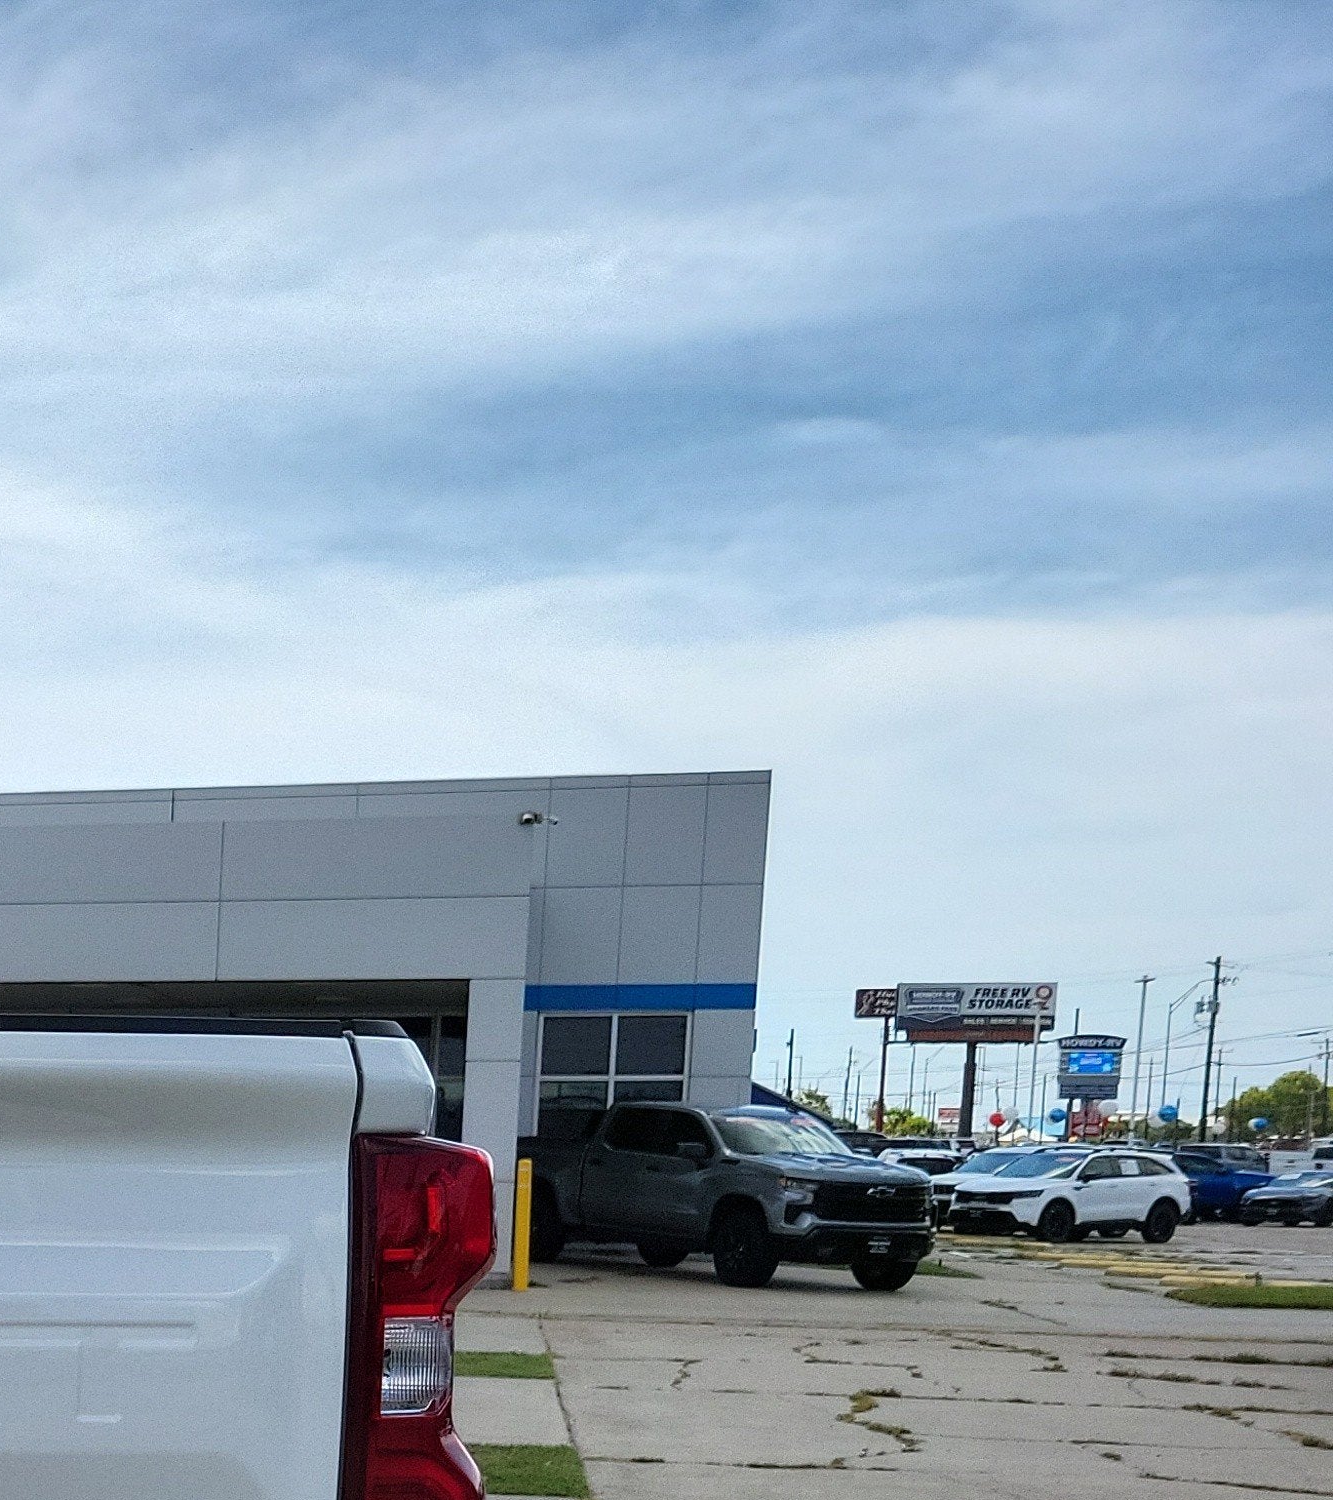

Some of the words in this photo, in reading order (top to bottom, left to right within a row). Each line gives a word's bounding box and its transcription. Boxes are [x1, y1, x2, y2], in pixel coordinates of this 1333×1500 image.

[974, 987, 1008, 998] FREE
[1011, 987, 1031, 998] RV
[967, 999, 1032, 1009] STORAGE
